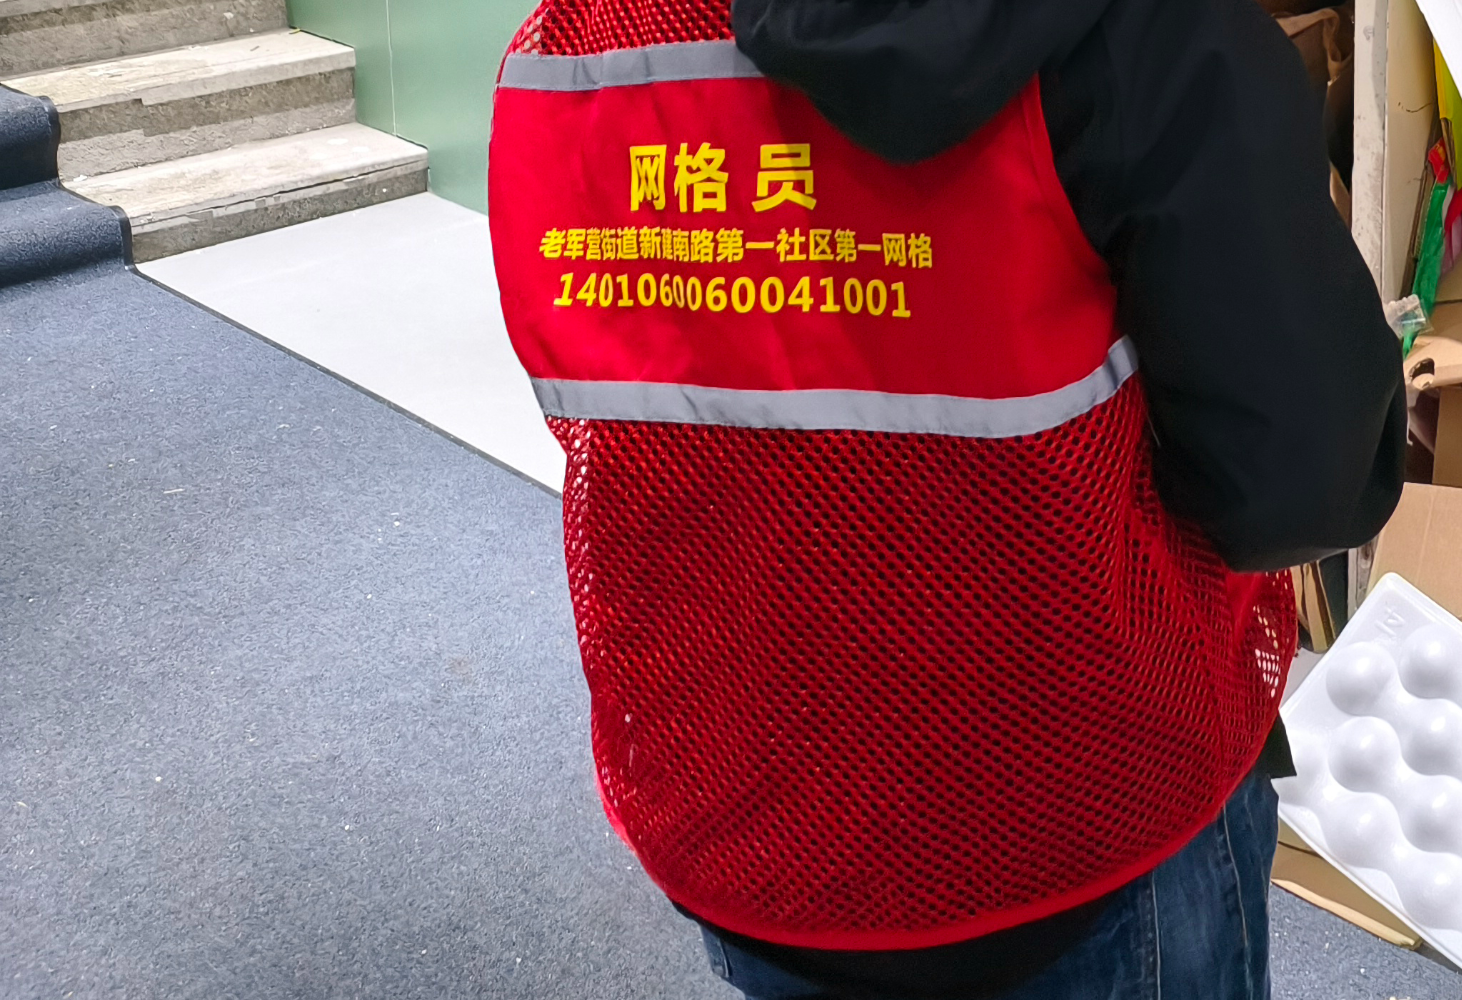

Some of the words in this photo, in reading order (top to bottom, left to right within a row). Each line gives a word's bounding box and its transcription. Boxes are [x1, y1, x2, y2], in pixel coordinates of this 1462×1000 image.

[539, 225, 933, 269] 老军营街道新建南路第一社区第一网格
[552, 272, 911, 319] 1401060060041001
